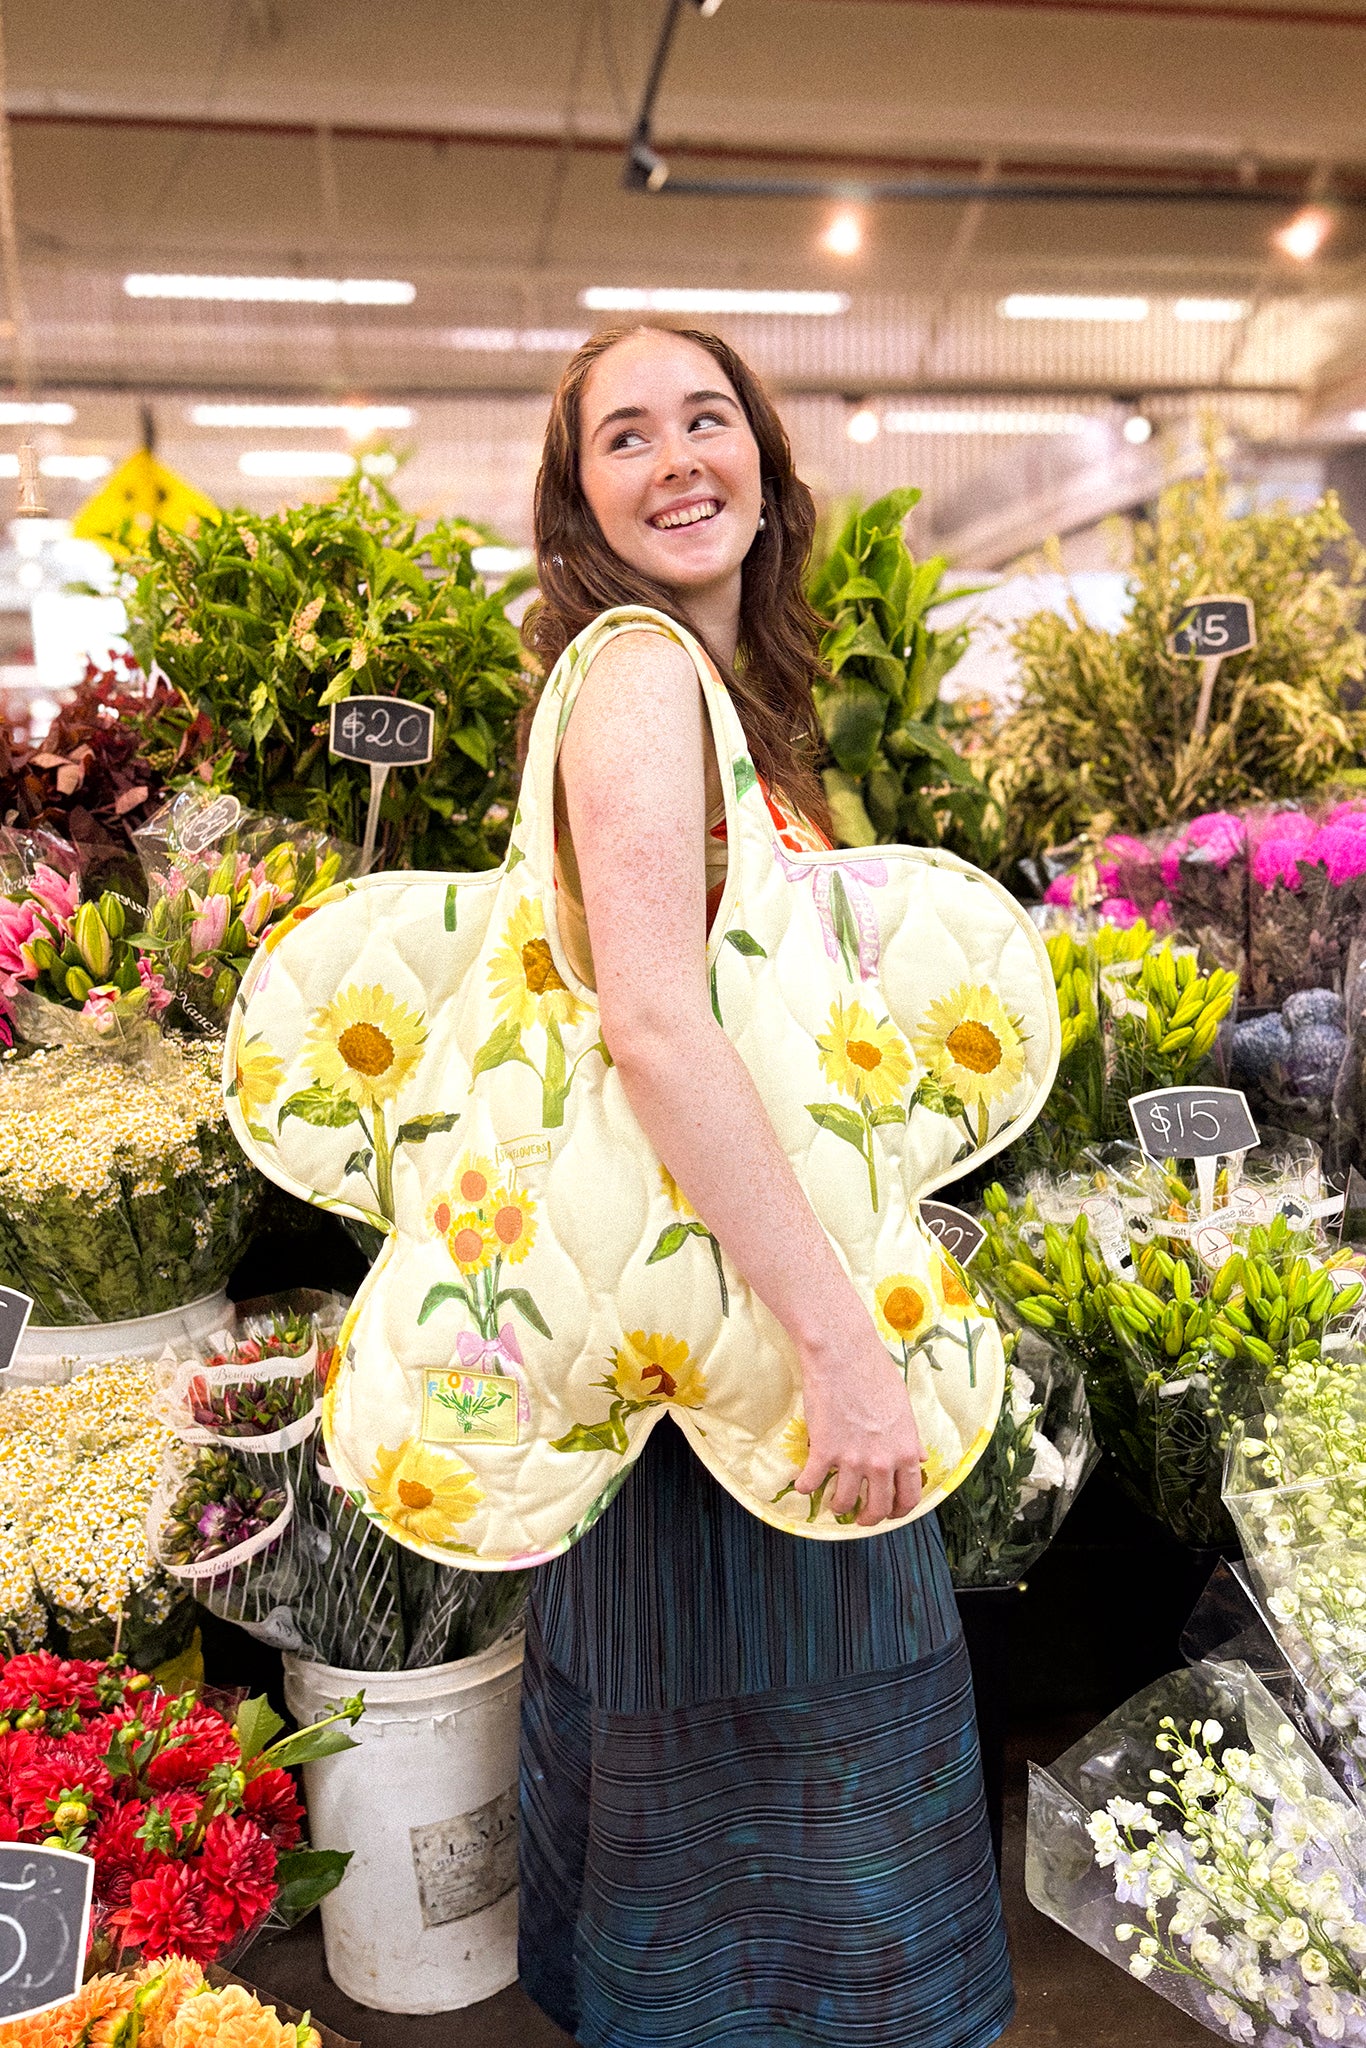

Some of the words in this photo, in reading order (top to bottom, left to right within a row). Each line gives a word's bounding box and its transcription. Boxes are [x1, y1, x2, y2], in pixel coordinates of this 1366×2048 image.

[342, 706, 422, 750] $20
[1149, 1100, 1220, 1143] $15
[427, 1372, 512, 1407] FLORIST
